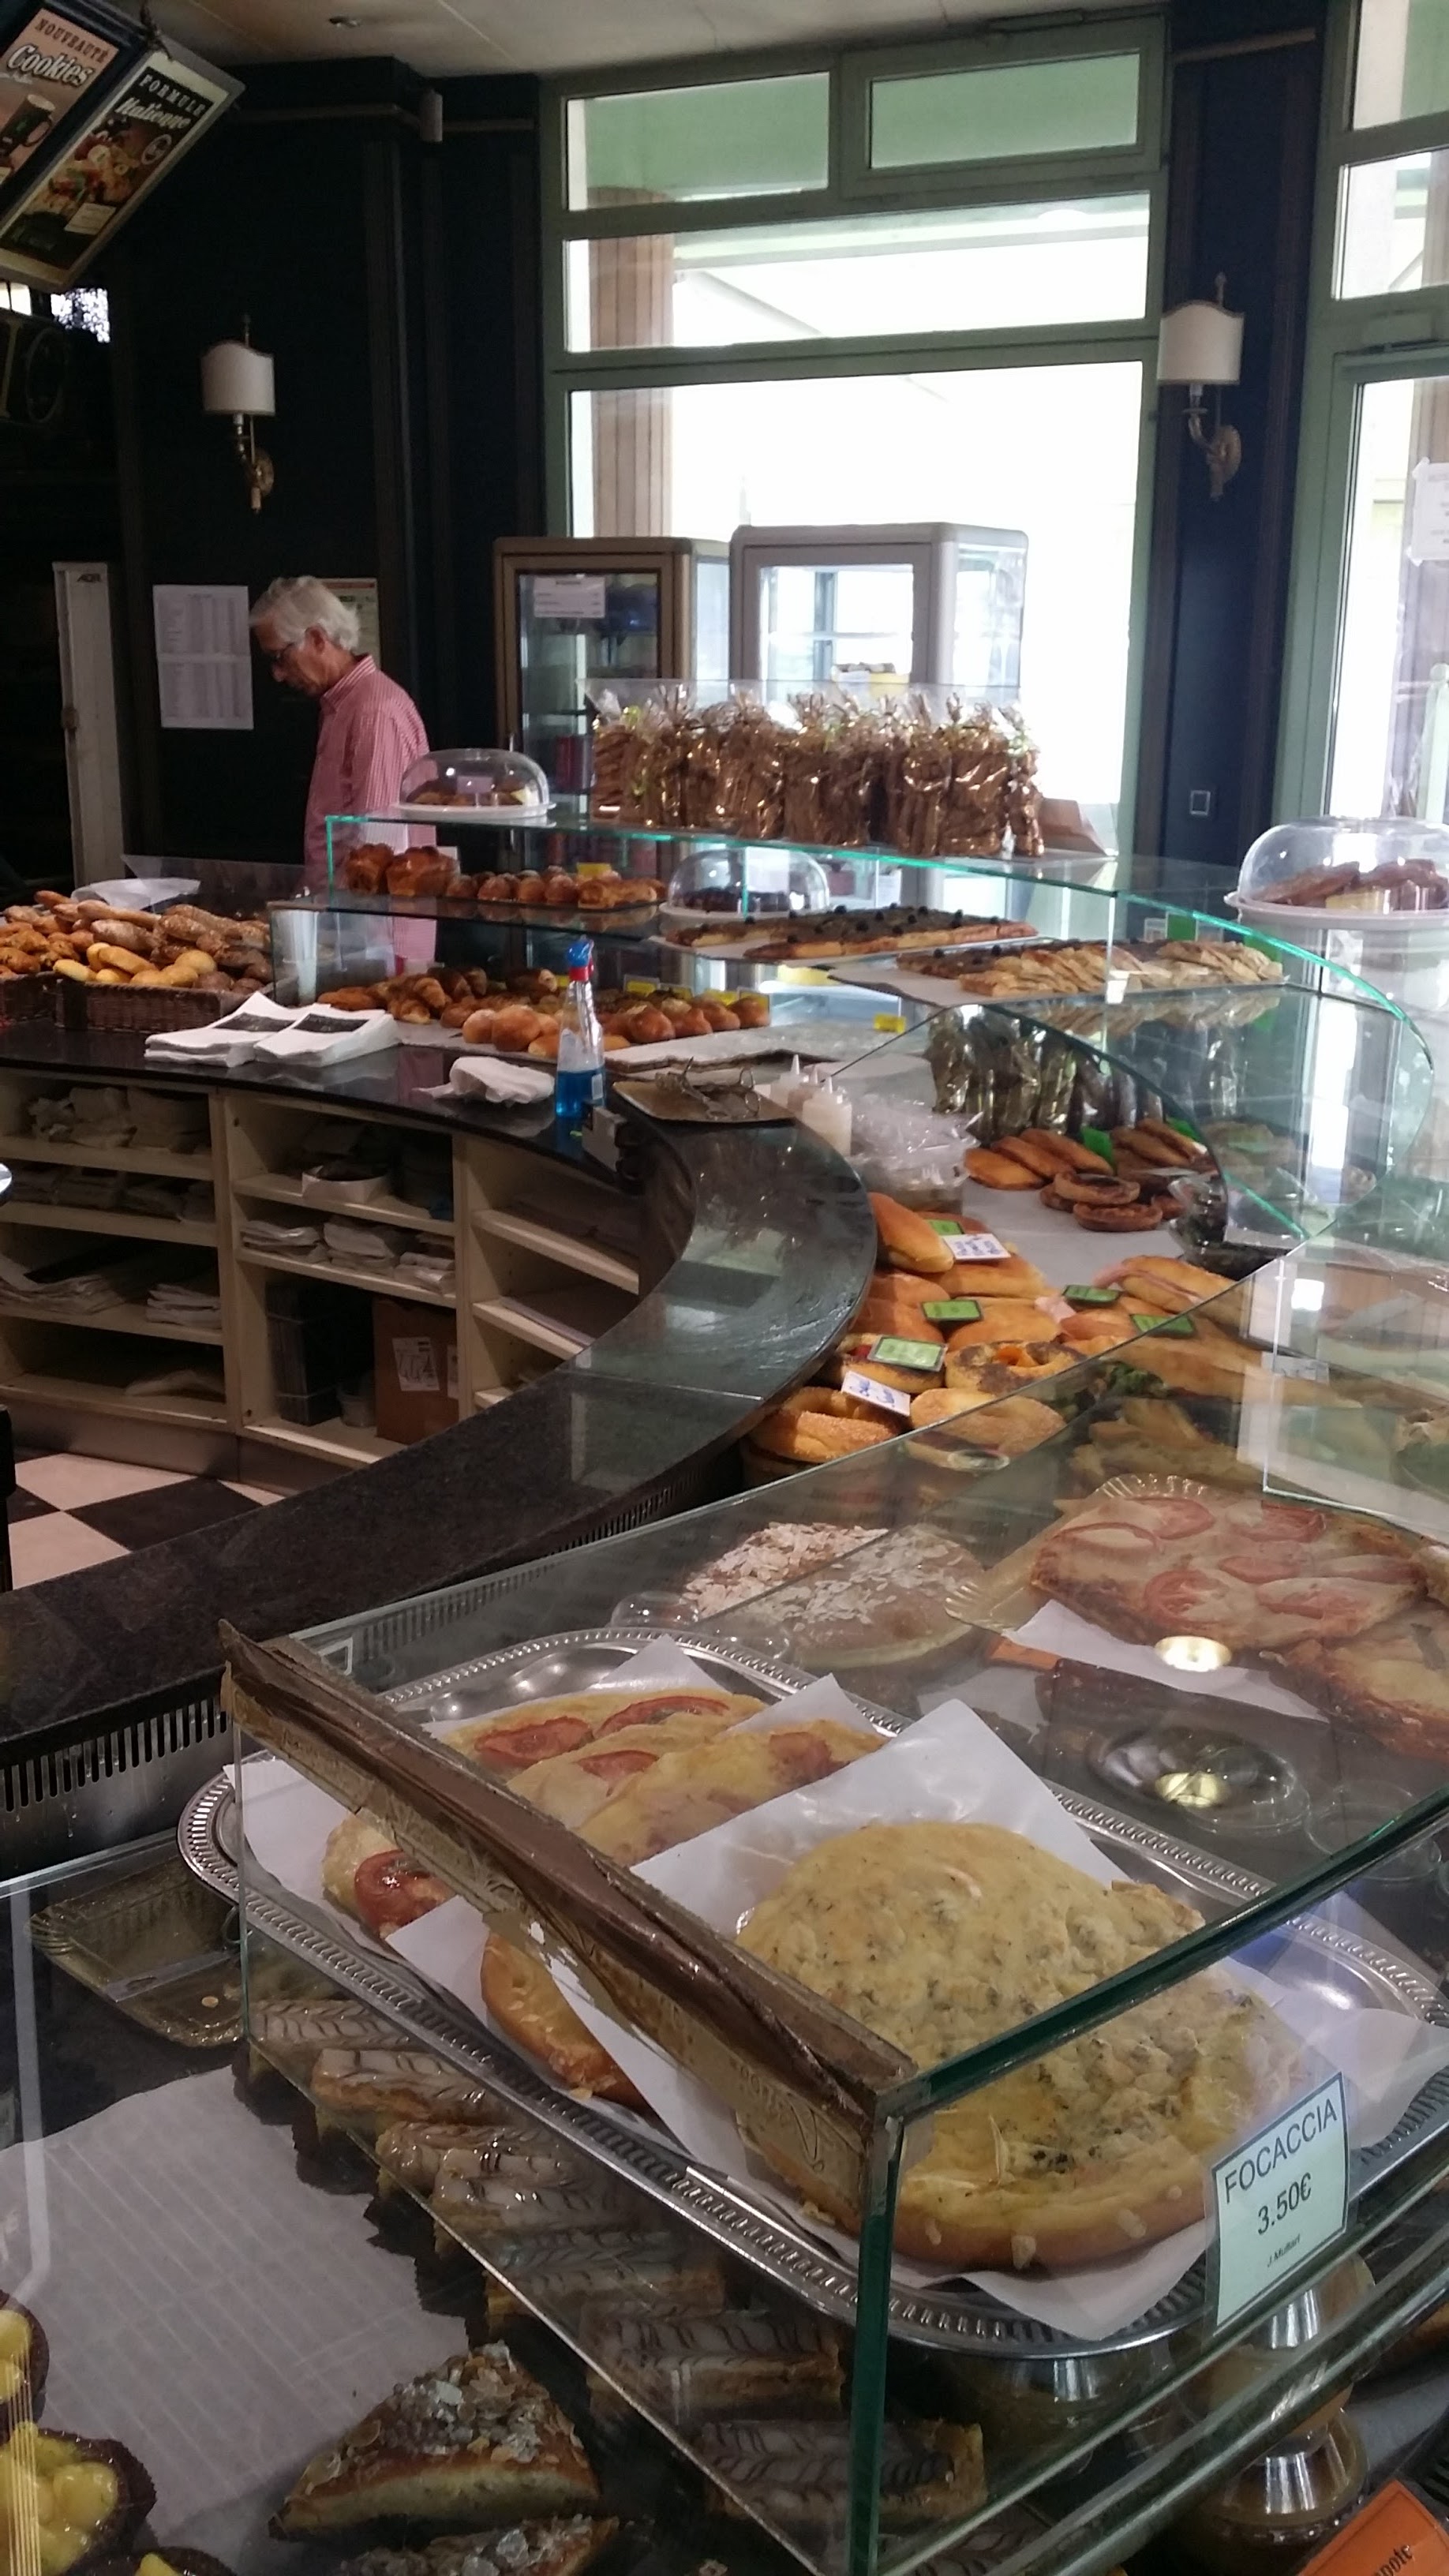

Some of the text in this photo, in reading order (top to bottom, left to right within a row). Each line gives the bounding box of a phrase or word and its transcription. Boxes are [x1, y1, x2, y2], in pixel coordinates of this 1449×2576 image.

[7, 43, 93, 87] Cookies
[138, 73, 206, 117] FORMULE
[1223, 2097, 1338, 2205] FOCACCIA
[1257, 2171, 1312, 2236] 3.50€
